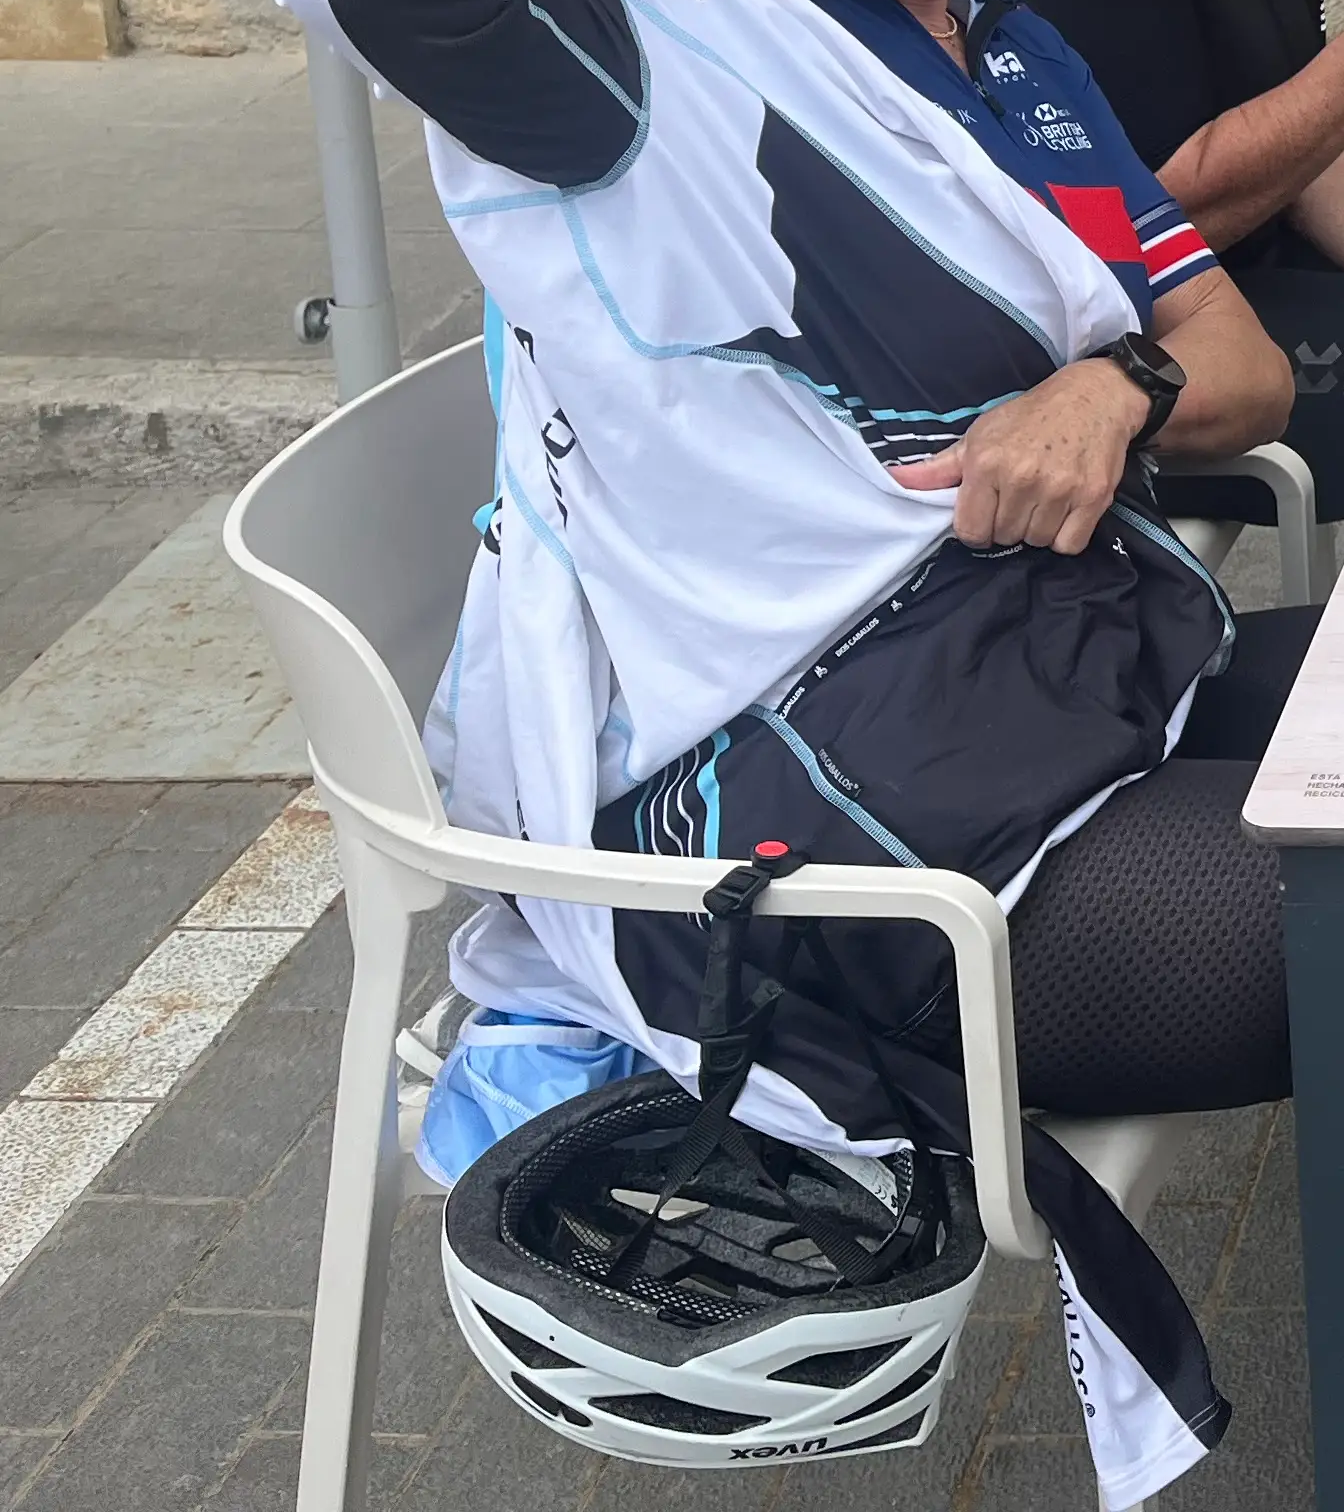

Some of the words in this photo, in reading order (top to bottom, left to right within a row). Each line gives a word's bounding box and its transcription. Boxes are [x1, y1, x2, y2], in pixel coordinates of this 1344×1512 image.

[835, 642, 851, 658] DOS
[848, 617, 880, 646] CABALLOS
[728, 1437, 828, 1460] uvex
